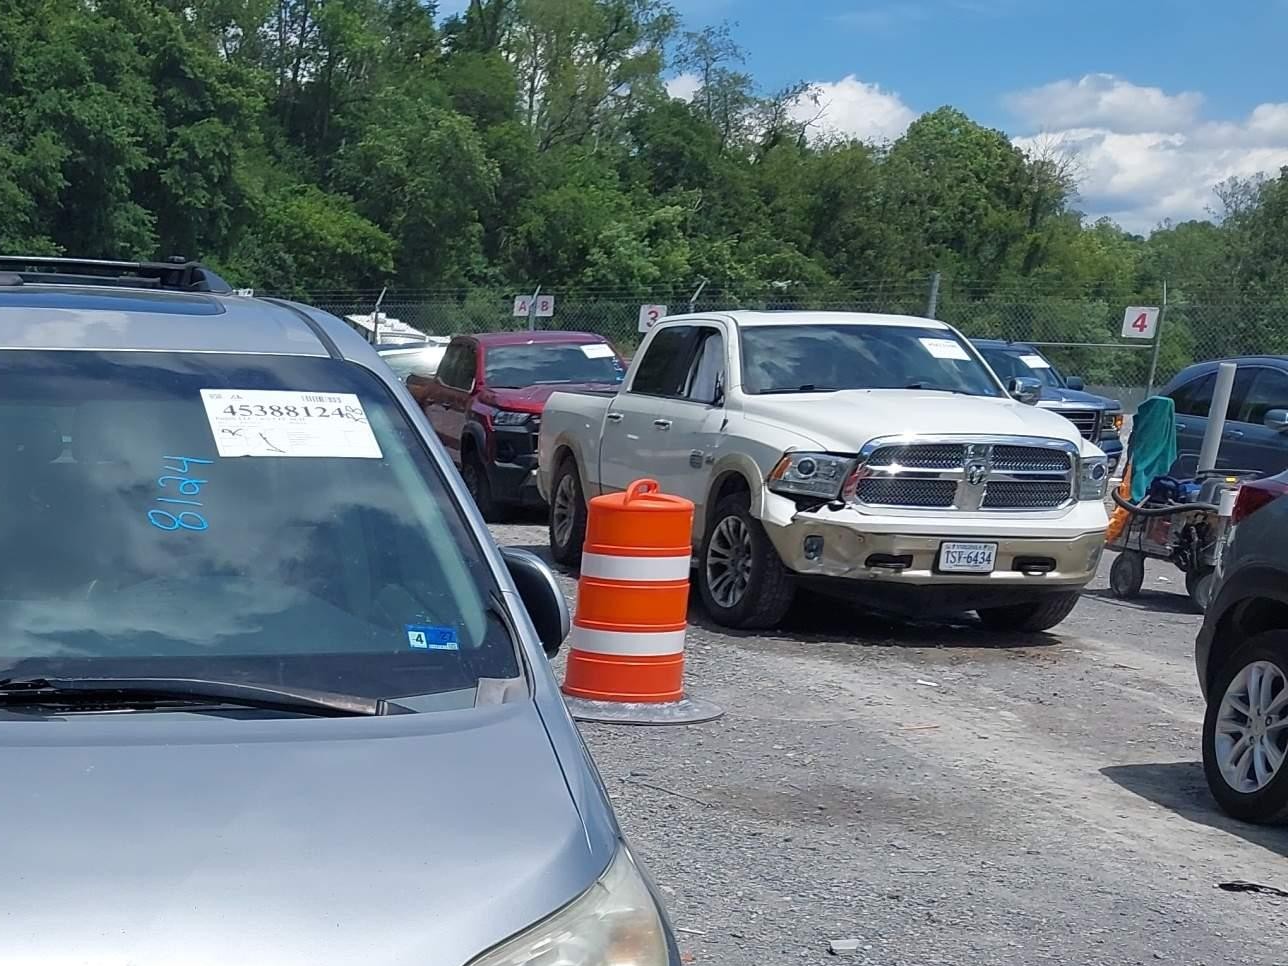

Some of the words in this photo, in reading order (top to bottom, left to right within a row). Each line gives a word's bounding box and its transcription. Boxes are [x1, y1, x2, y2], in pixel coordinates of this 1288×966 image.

[518, 300, 527, 312] A
[540, 300, 549, 312] B
[646, 310, 659, 328] 3
[1132, 312, 1148, 333] 4
[223, 404, 345, 419] 45388124
[147, 455, 214, 532] 8124
[416, 633, 424, 645] 4
